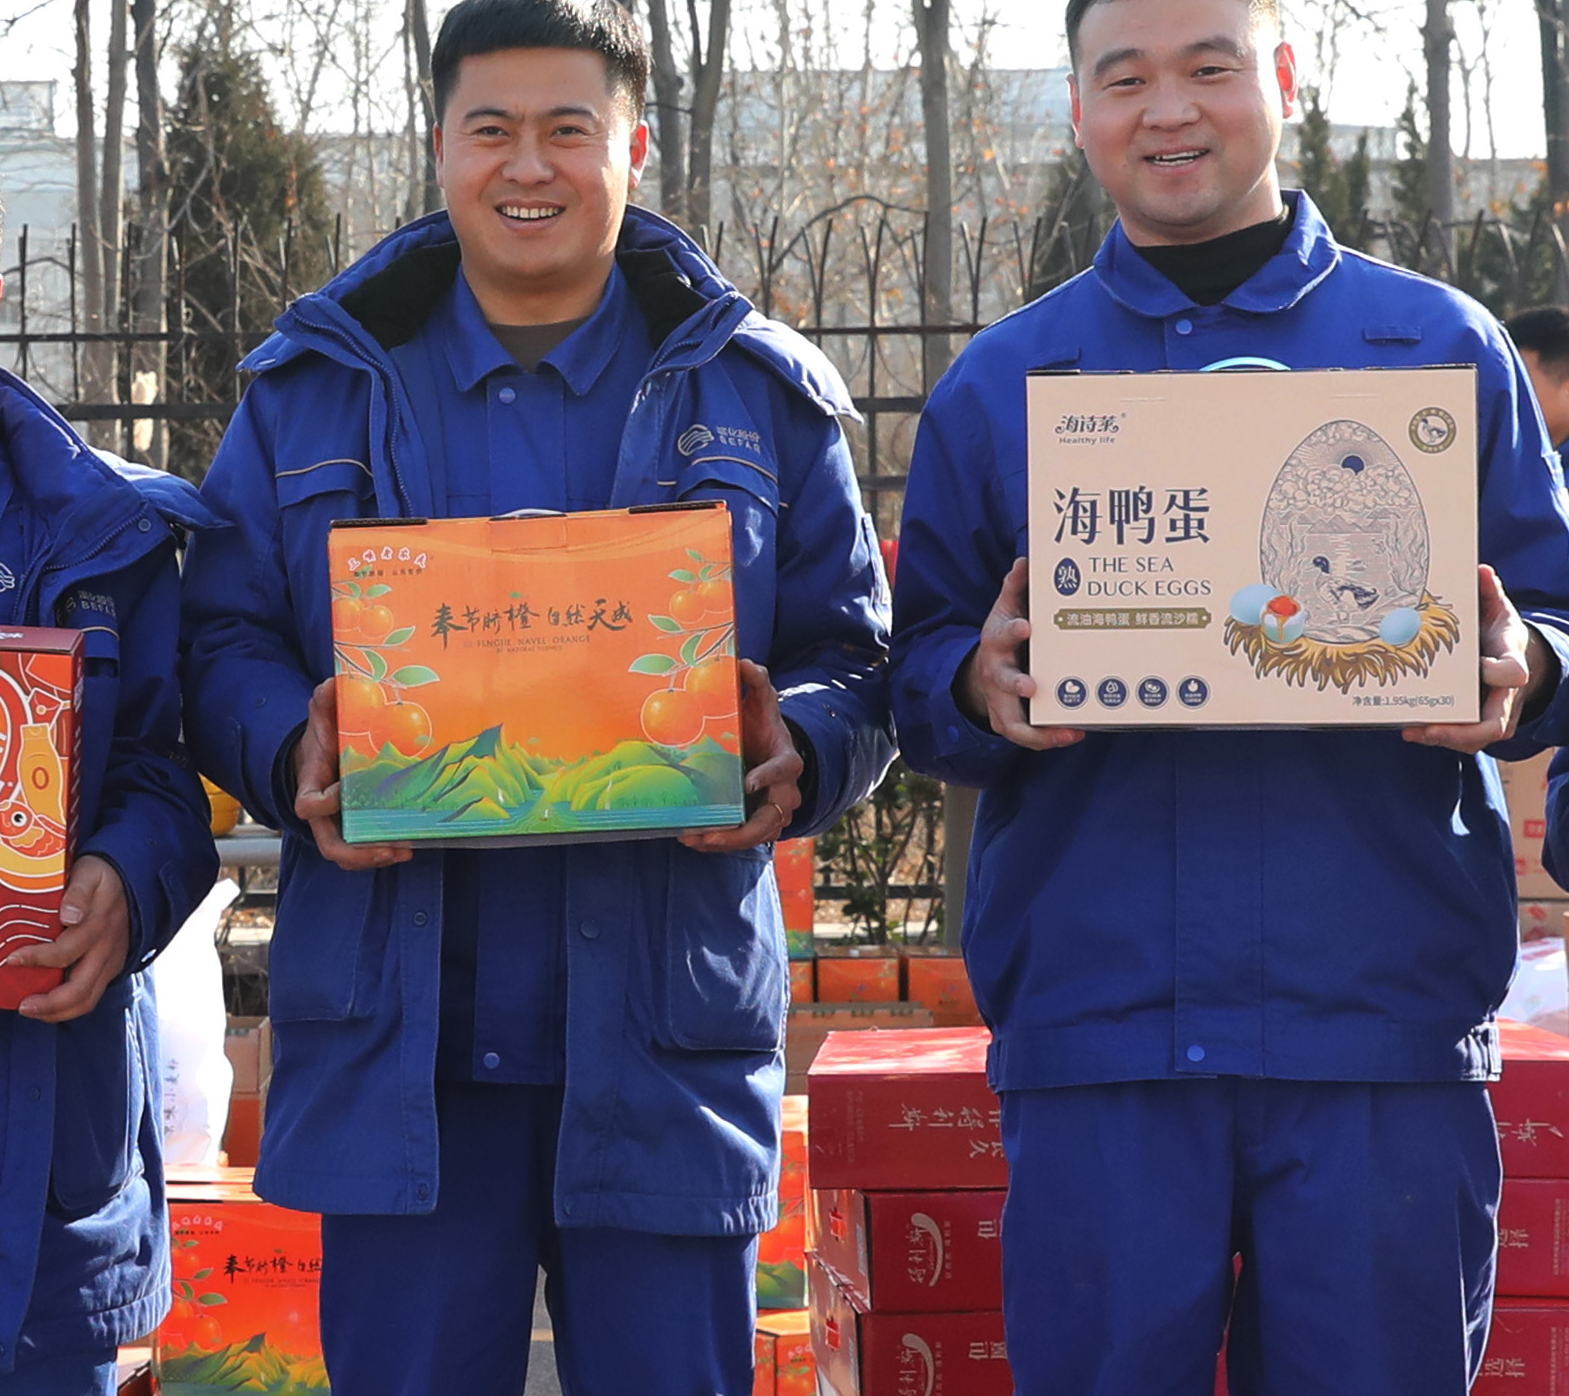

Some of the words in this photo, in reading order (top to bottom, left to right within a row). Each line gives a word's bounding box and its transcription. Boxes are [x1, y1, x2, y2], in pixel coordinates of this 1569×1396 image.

[1060, 435, 1095, 445] Healthy
[1097, 435, 1116, 444] life
[1054, 486, 1210, 545] 海鸭蛋
[1089, 557, 1130, 573] THE
[1135, 557, 1174, 573] SEA
[1088, 581, 1148, 596] DUCK
[1154, 580, 1212, 596] EGGS
[431, 602, 540, 652] 奉节脐橙
[548, 598, 633, 632] 自然天成
